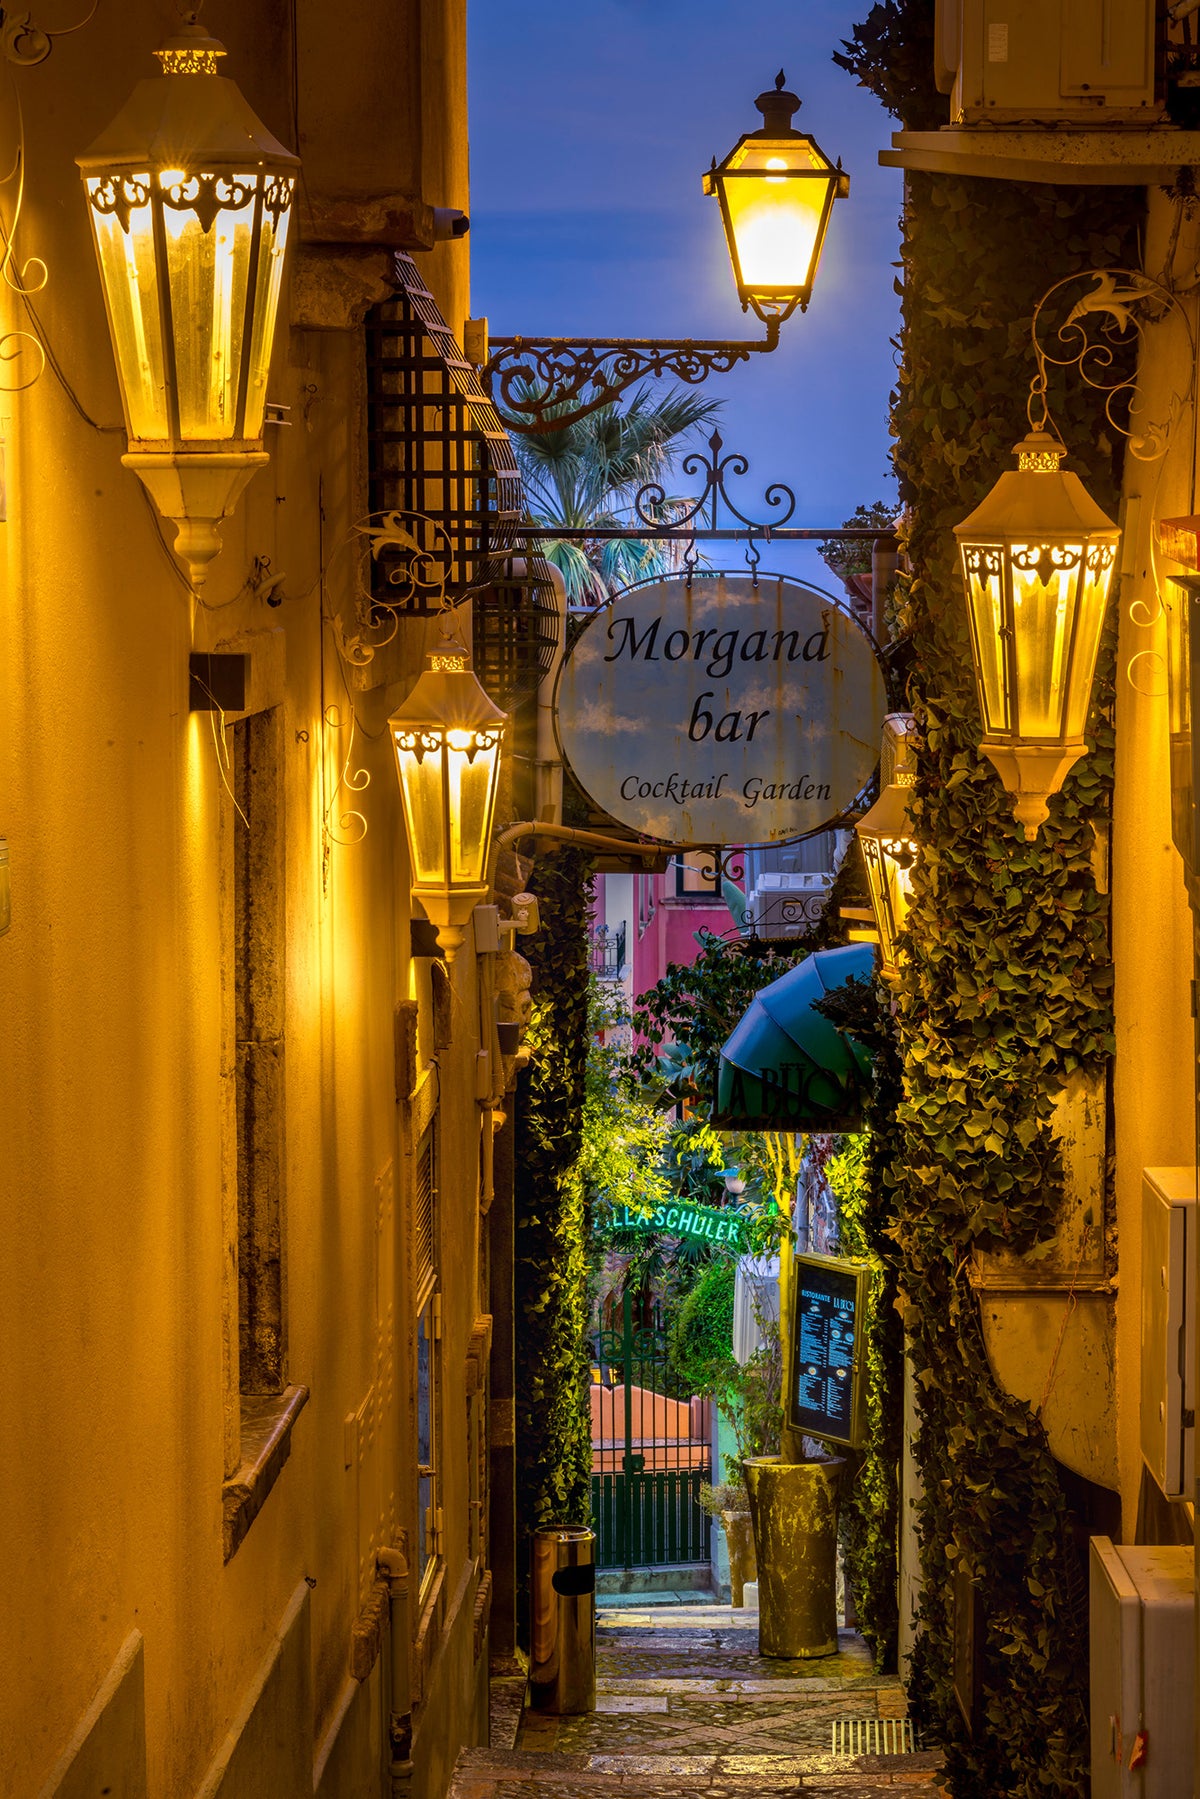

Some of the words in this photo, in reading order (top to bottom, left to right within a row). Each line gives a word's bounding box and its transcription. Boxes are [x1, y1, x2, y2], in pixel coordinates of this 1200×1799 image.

[603, 616, 832, 679] Morgana
[688, 691, 770, 742] bar
[620, 772, 729, 804] Cocktail
[743, 774, 832, 808] Garden
